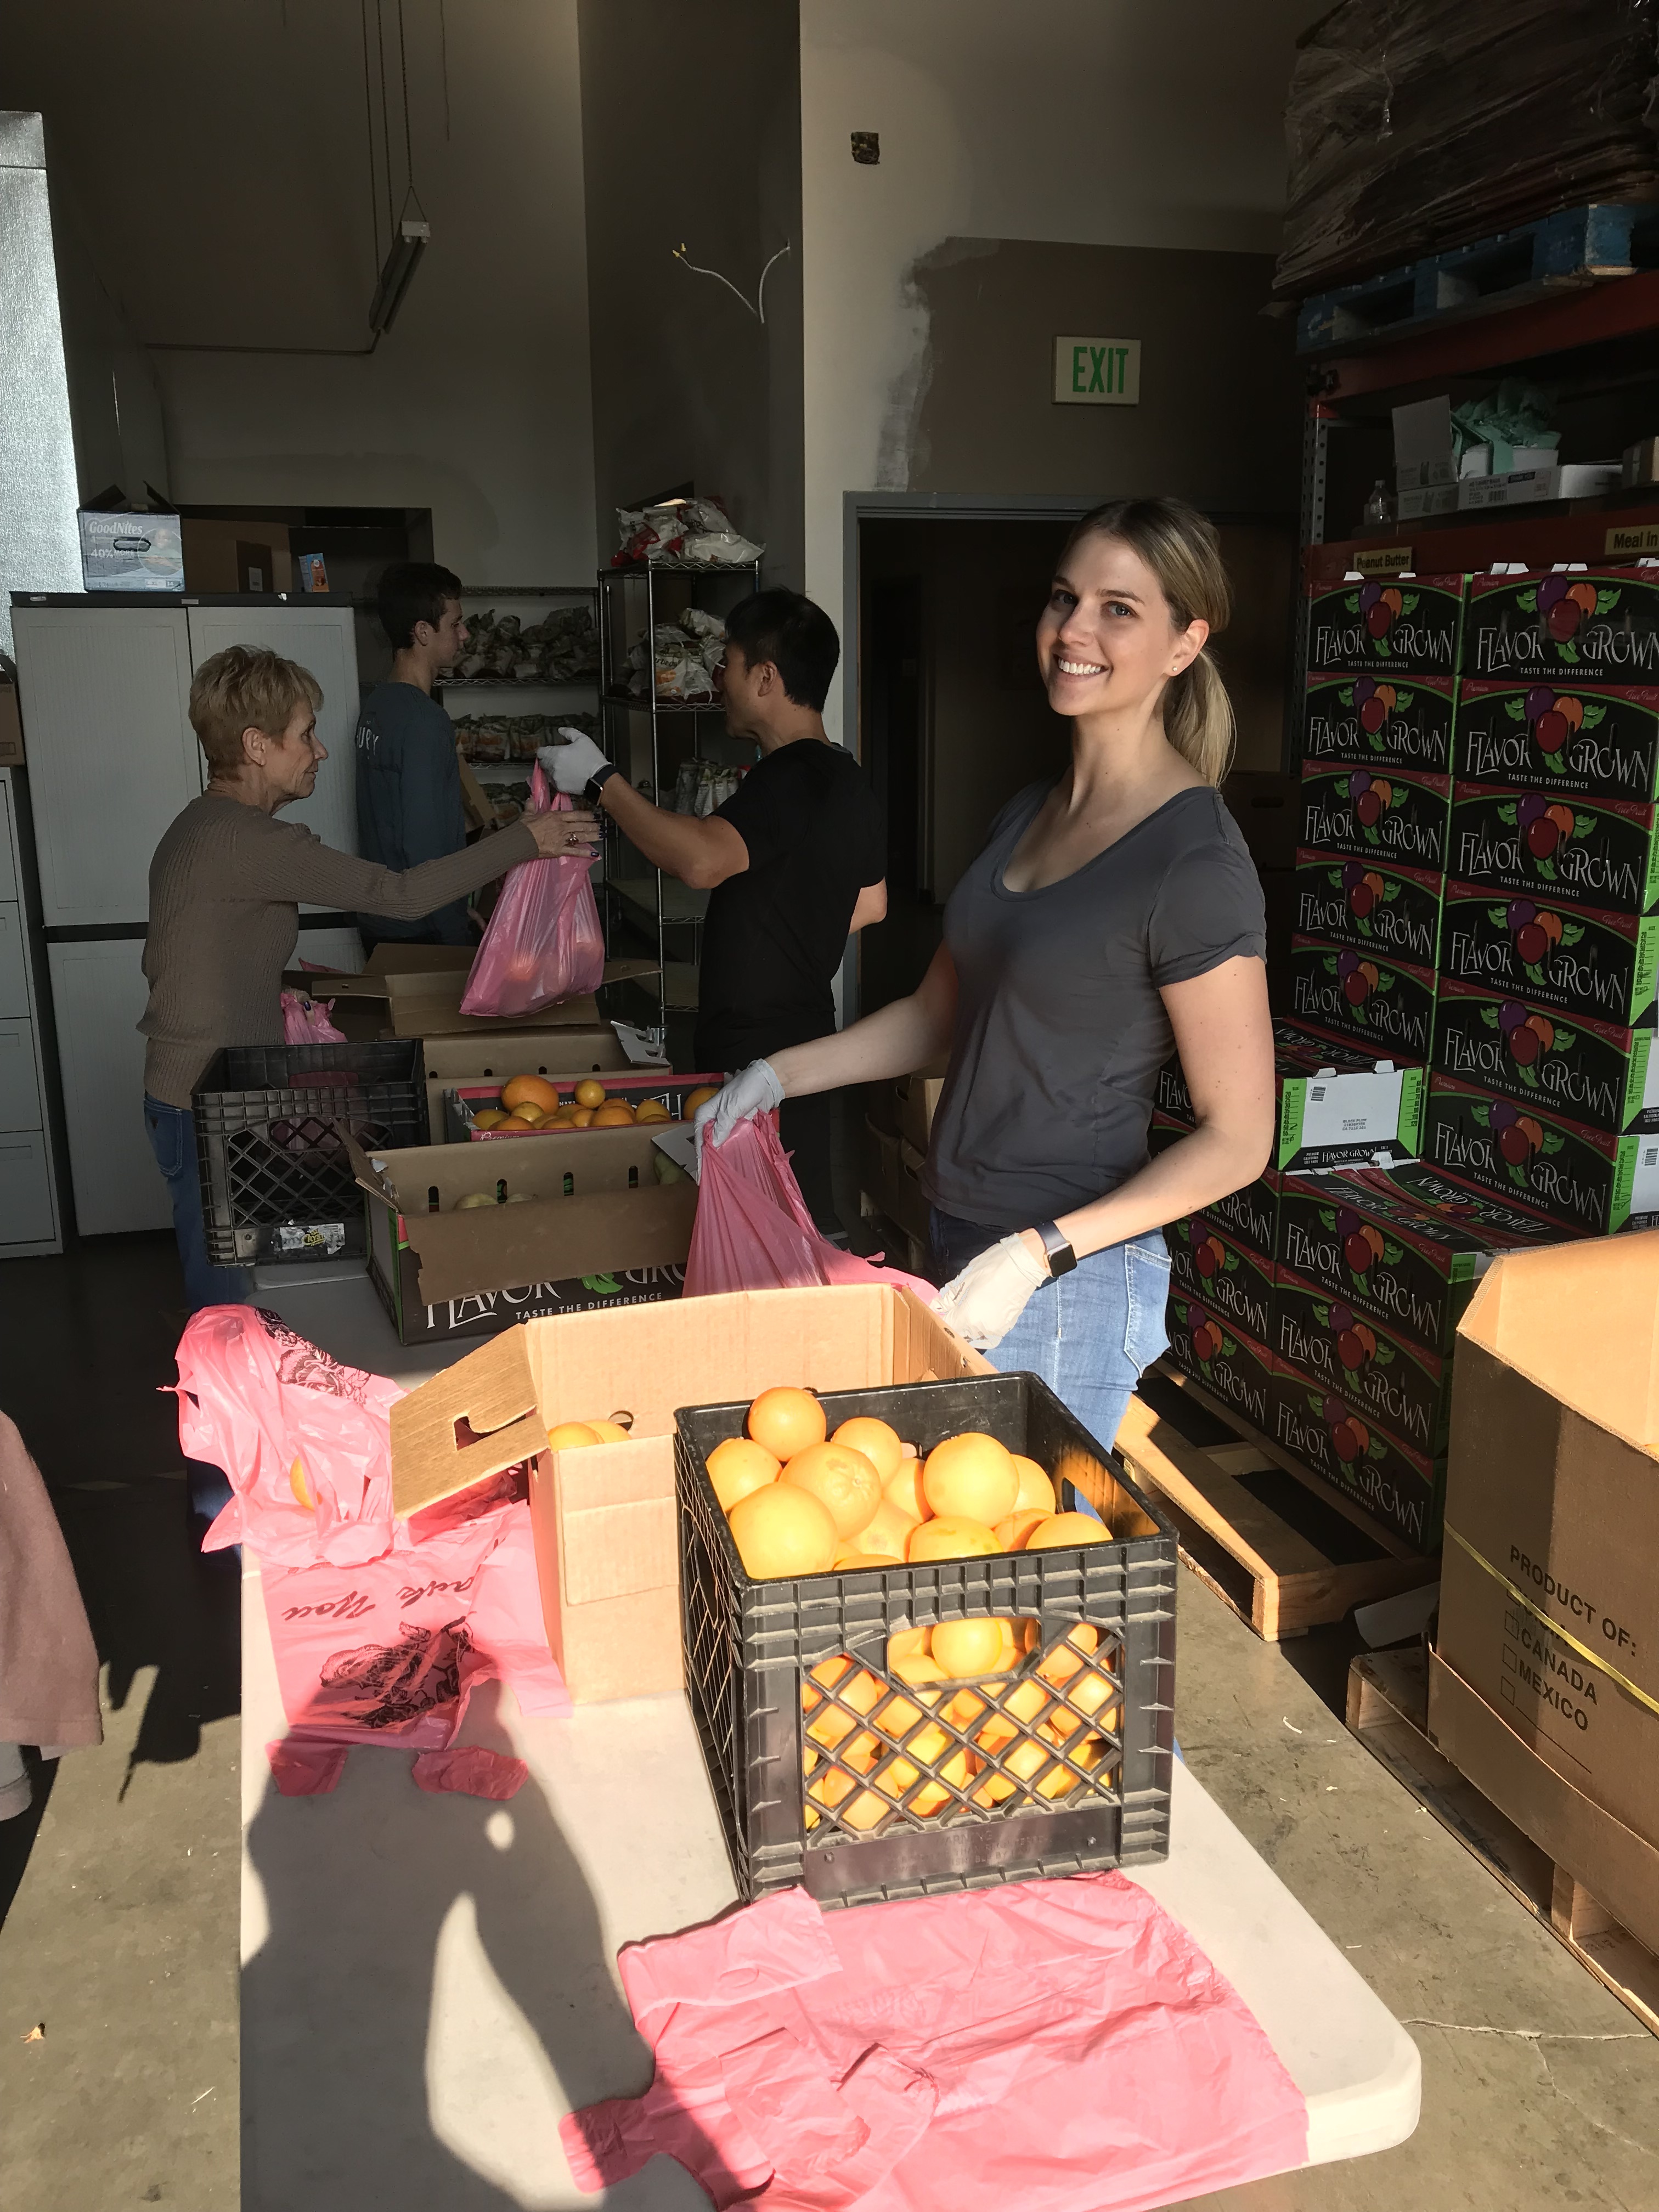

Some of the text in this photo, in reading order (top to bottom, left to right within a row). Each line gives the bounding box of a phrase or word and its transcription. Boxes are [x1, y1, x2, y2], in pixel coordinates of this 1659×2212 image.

[1073, 346, 1128, 393] EXIT
[89, 521, 143, 534] GoodNites
[1613, 531, 1658, 549] Meal in
[1357, 554, 1409, 569] Peanut Butter
[1316, 620, 1455, 665] FLAVOR GROWN
[1477, 625, 1545, 673] FLAVOR
[1308, 716, 1448, 766] FLAVOR GROWN
[1370, 755, 1402, 764] DIFFERENCE
[1465, 731, 1654, 792] FLAVOR GROWN
[1508, 773, 1589, 789] TASTE THE DIFFERENCE
[1305, 805, 1443, 863] FLAVOR GROWN
[1336, 843, 1397, 859] TASTE THE DIFFERENCE
[1459, 832, 1642, 905] FLAVOR GROWN
[1500, 876, 1580, 898] TASTE THE DIFFERENCE
[1299, 893, 1435, 960] FLAVOR GROWN
[1330, 932, 1345, 940] TASTE
[1357, 939, 1389, 952] DIFFERENCE
[1451, 932, 1629, 1015] FLAVOR GROWN
[1490, 978, 1568, 1004] TASTE THE DIFFERENCE
[1294, 975, 1430, 1052] FLAVOR GROWN
[1325, 1017, 1384, 1041] TASTE THE DIFFERENCE
[1159, 1070, 1193, 1110] FLAVO
[1444, 1028, 1507, 1077] FLAVOR
[1541, 1059, 1620, 1123] GROWN
[1484, 1075, 1560, 1108] TASTE THE DIFFERENCE
[1322, 1150, 1348, 1163] FLAVOR
[1435, 1122, 1497, 1175] FLAVOR
[1531, 1161, 1607, 1229] GROWN
[1474, 1172, 1492, 1186] TASTE
[1494, 1180, 1506, 1192] THE
[1509, 1186, 1549, 1209] DIFFERENCE
[1221, 1193, 1273, 1250] GROWN
[516, 1292, 662, 1321] TASTE THE DIFFERENCE
[1180, 1279, 1230, 1318] TASTE THE DIFFERENCE
[1286, 1222, 1442, 1345] FLAVOR GROWN
[1322, 1276, 1389, 1320] TASTE THE DIFFERENCE
[1216, 1277, 1268, 1340] GROWN
[1214, 1362, 1266, 1426] GROWN
[1280, 1314, 1432, 1447] FLAVOR GROWN
[1314, 1370, 1380, 1418] TASTE THE DIFFERENCE
[1277, 1401, 1425, 1544] FLAVOR GROWN
[1310, 1459, 1375, 1511] TASTE THE DIFFERENCE
[281, 1576, 475, 1621] ank You
[1510, 1544, 1596, 1624] PRODUCT
[1602, 1618, 1637, 1658] OF:
[1521, 1625, 1597, 1706] CANADA
[1520, 1659, 1589, 1731] MEXICO
